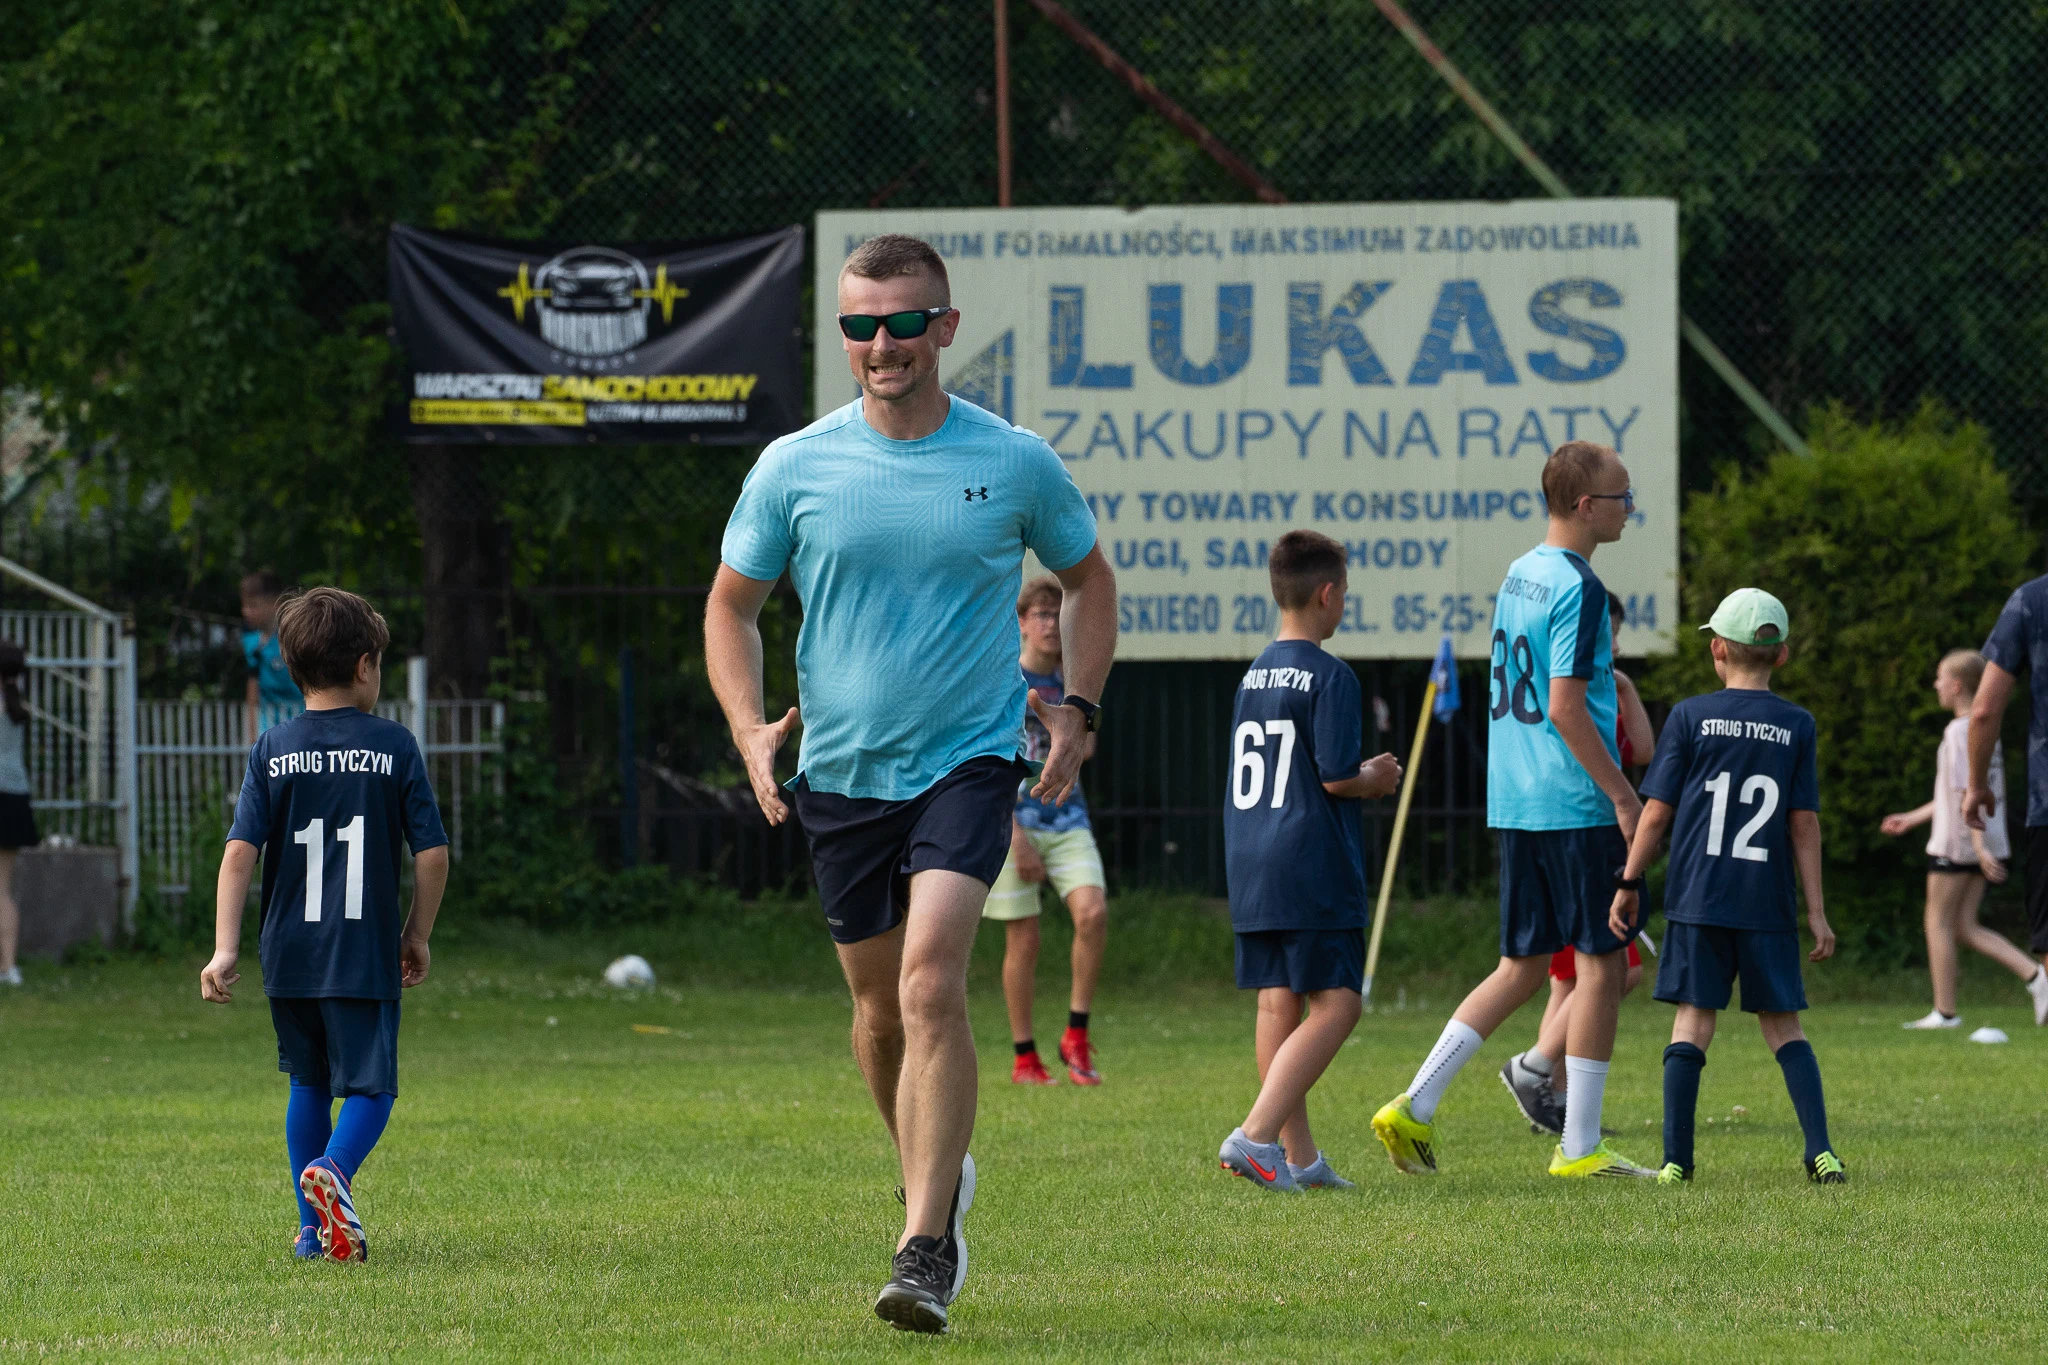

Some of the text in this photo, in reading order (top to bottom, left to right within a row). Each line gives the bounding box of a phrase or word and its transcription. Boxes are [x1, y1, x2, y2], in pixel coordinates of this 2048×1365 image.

[995, 225, 1223, 260] FORMALNOŚCI,
[1231, 227, 1405, 254] MAKSIMUM
[1415, 223, 1641, 252] ZADOWOLENIA
[1049, 275, 1628, 389] LUKAS
[1043, 405, 1640, 461] ZAKUPY NA RATY
[1137, 492, 1298, 522] TOWARY
[1112, 539, 1189, 576] UGI,
[1118, 594, 1220, 634] SKIEGO
[1338, 594, 1379, 632] EL.
[1490, 629, 1544, 724] 38
[1701, 718, 1791, 746] STRUG TYCZYN
[269, 749, 393, 778] STRUG TYCZYN
[1233, 719, 1296, 810] 67
[1704, 771, 1780, 863] 12
[294, 815, 364, 922] 11
